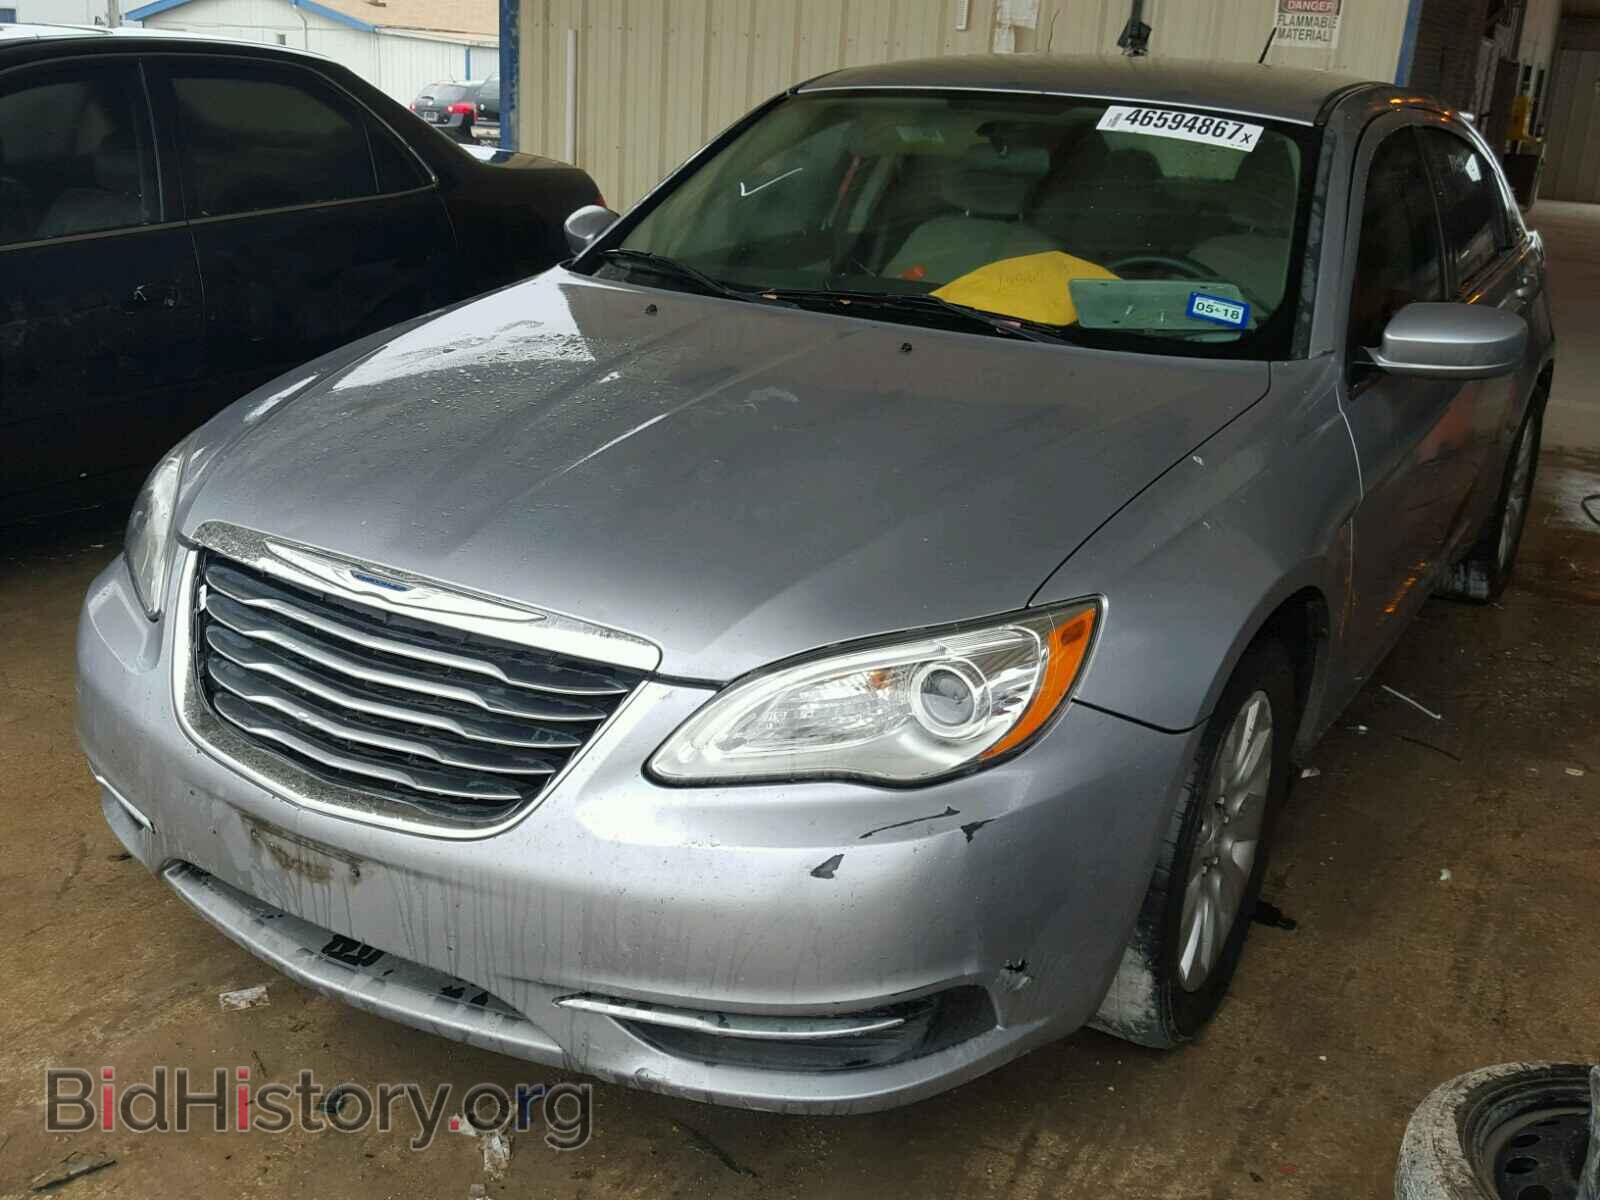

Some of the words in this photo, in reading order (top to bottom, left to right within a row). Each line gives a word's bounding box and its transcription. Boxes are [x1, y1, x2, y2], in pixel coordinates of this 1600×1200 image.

[1277, 15, 1338, 29] FLAMMABLE
[1276, 28, 1331, 42] MATERIAL
[1125, 109, 1244, 140] 46594867
